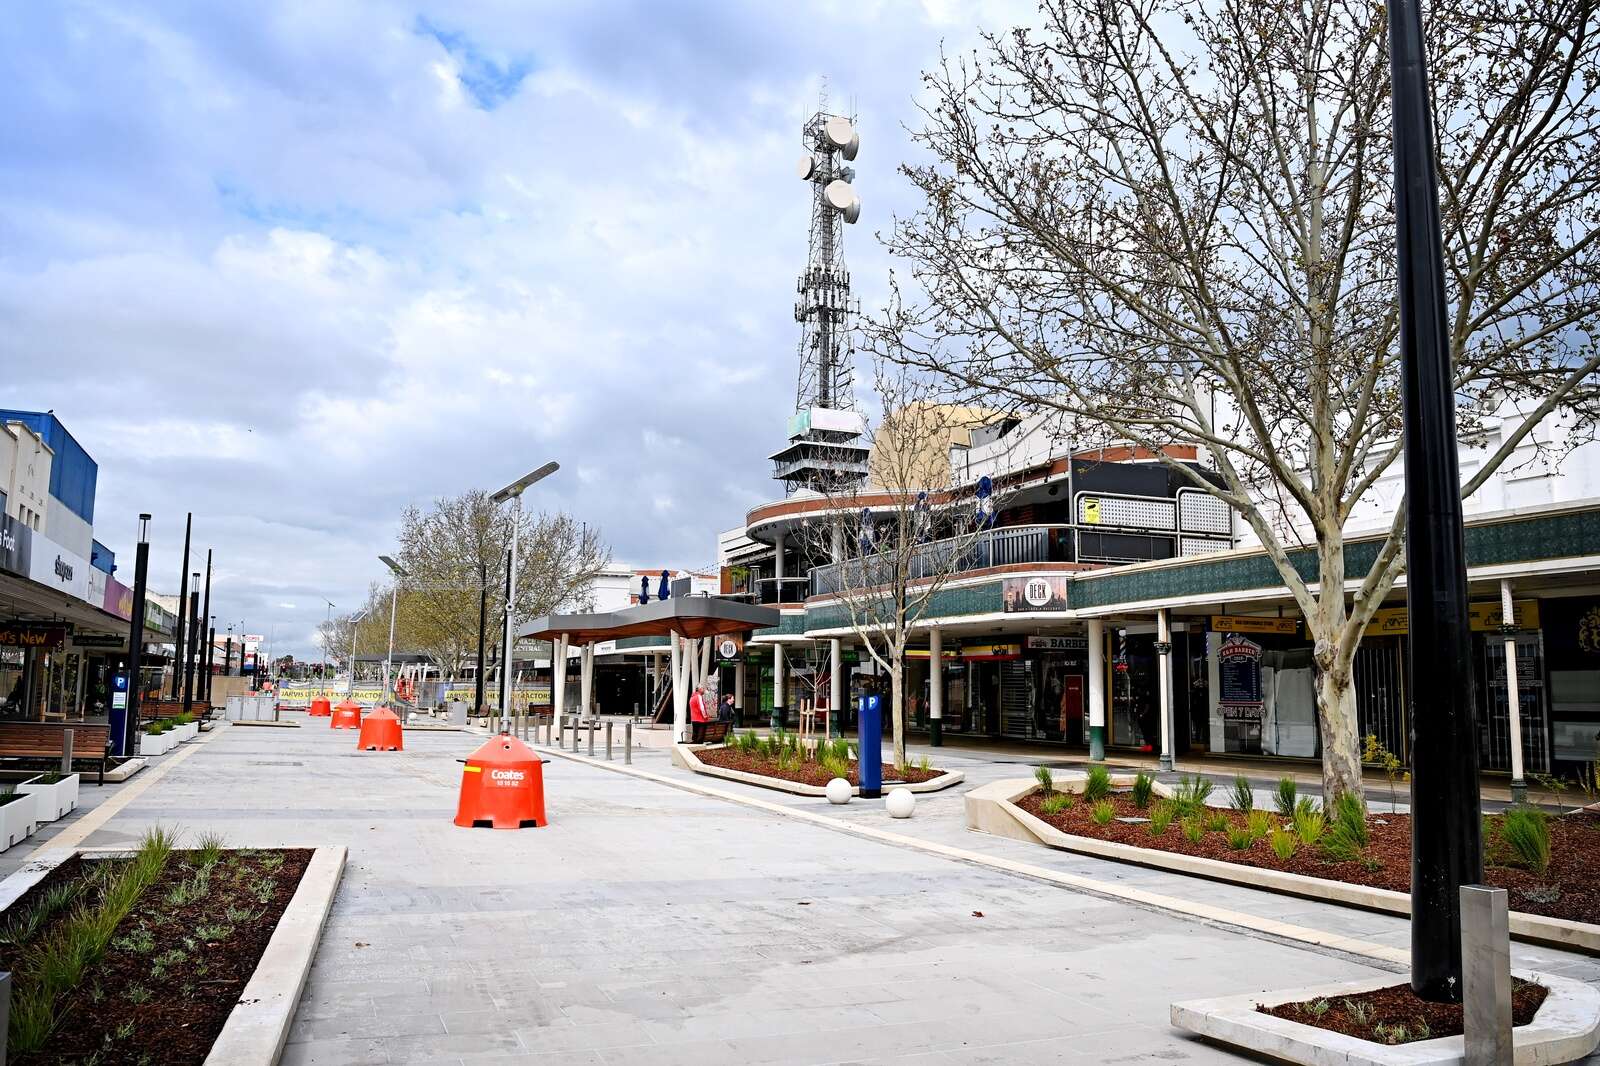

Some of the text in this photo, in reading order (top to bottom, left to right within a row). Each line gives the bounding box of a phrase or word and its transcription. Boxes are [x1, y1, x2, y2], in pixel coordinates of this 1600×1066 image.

[3, 529, 15, 552] Foot
[1029, 584, 1047, 599] DECK
[281, 690, 304, 698] JARVIS
[1238, 706, 1244, 718] 7
[491, 770, 524, 780] Coates
